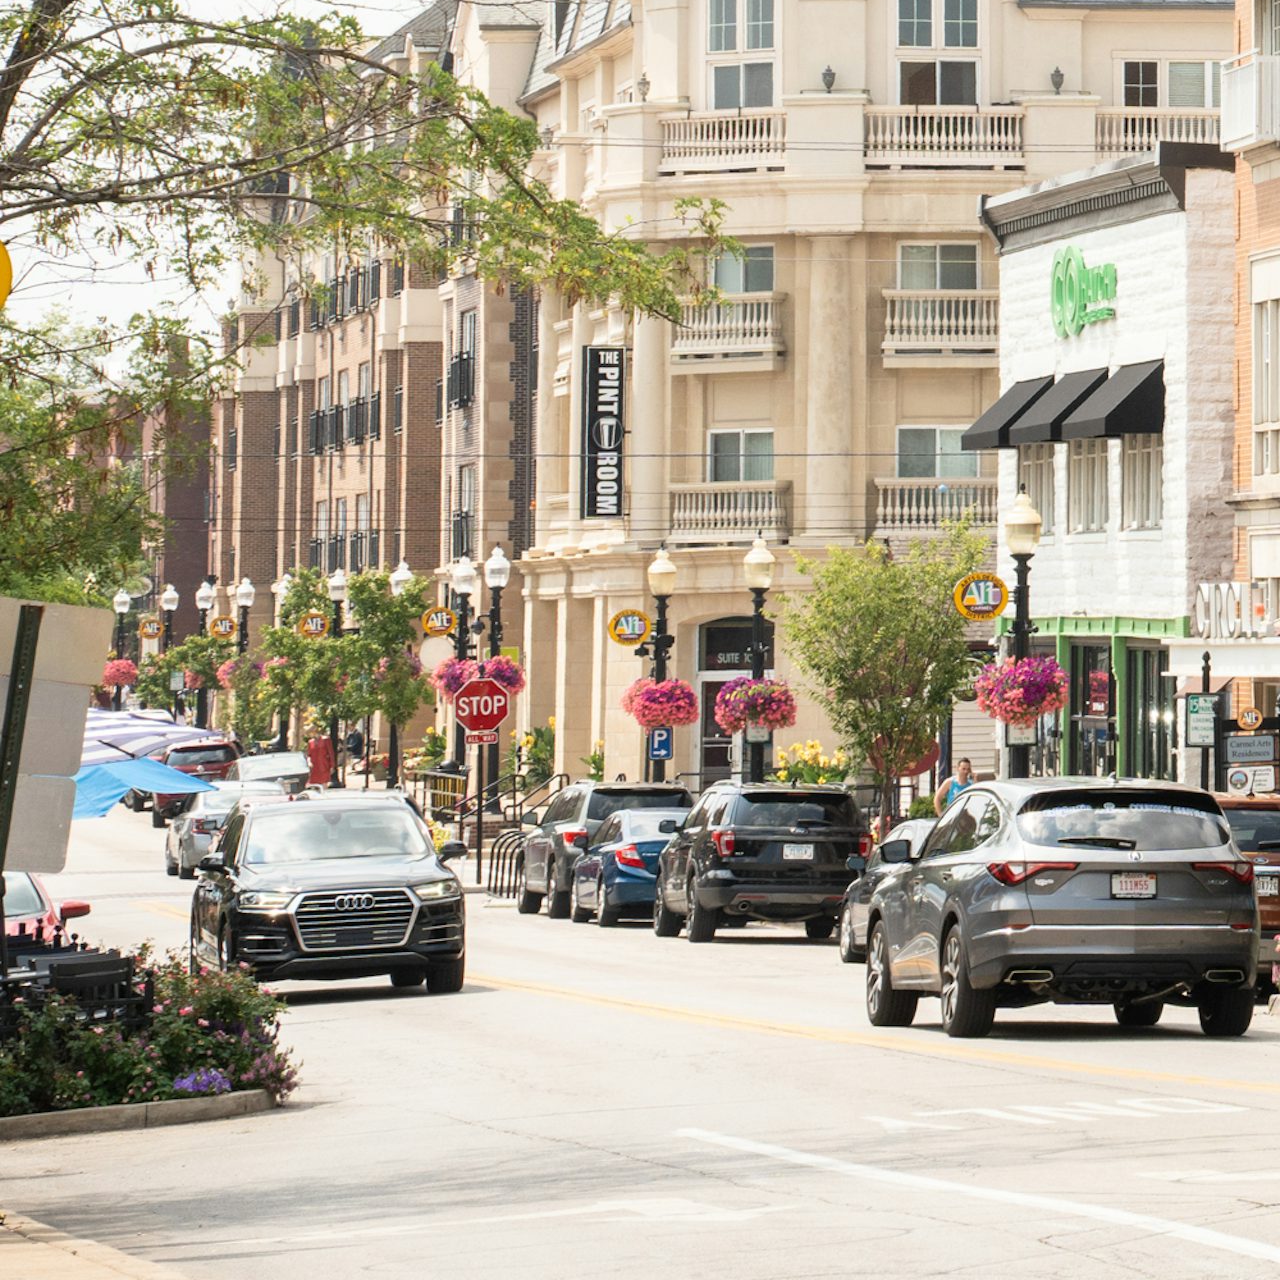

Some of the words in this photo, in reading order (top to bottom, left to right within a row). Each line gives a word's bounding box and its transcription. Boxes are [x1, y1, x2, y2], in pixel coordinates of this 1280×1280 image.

[599, 351, 619, 365] THE
[597, 367, 620, 415] PINT
[596, 452, 619, 515] ROOM
[717, 652, 740, 664] SUITE
[458, 695, 505, 717] STOP
[467, 734, 480, 743] ALL
[482, 734, 496, 742] WAY
[653, 730, 668, 749] P
[1230, 739, 1255, 749] Carmel
[1256, 738, 1271, 747] Arts
[1231, 749, 1270, 758] Residences
